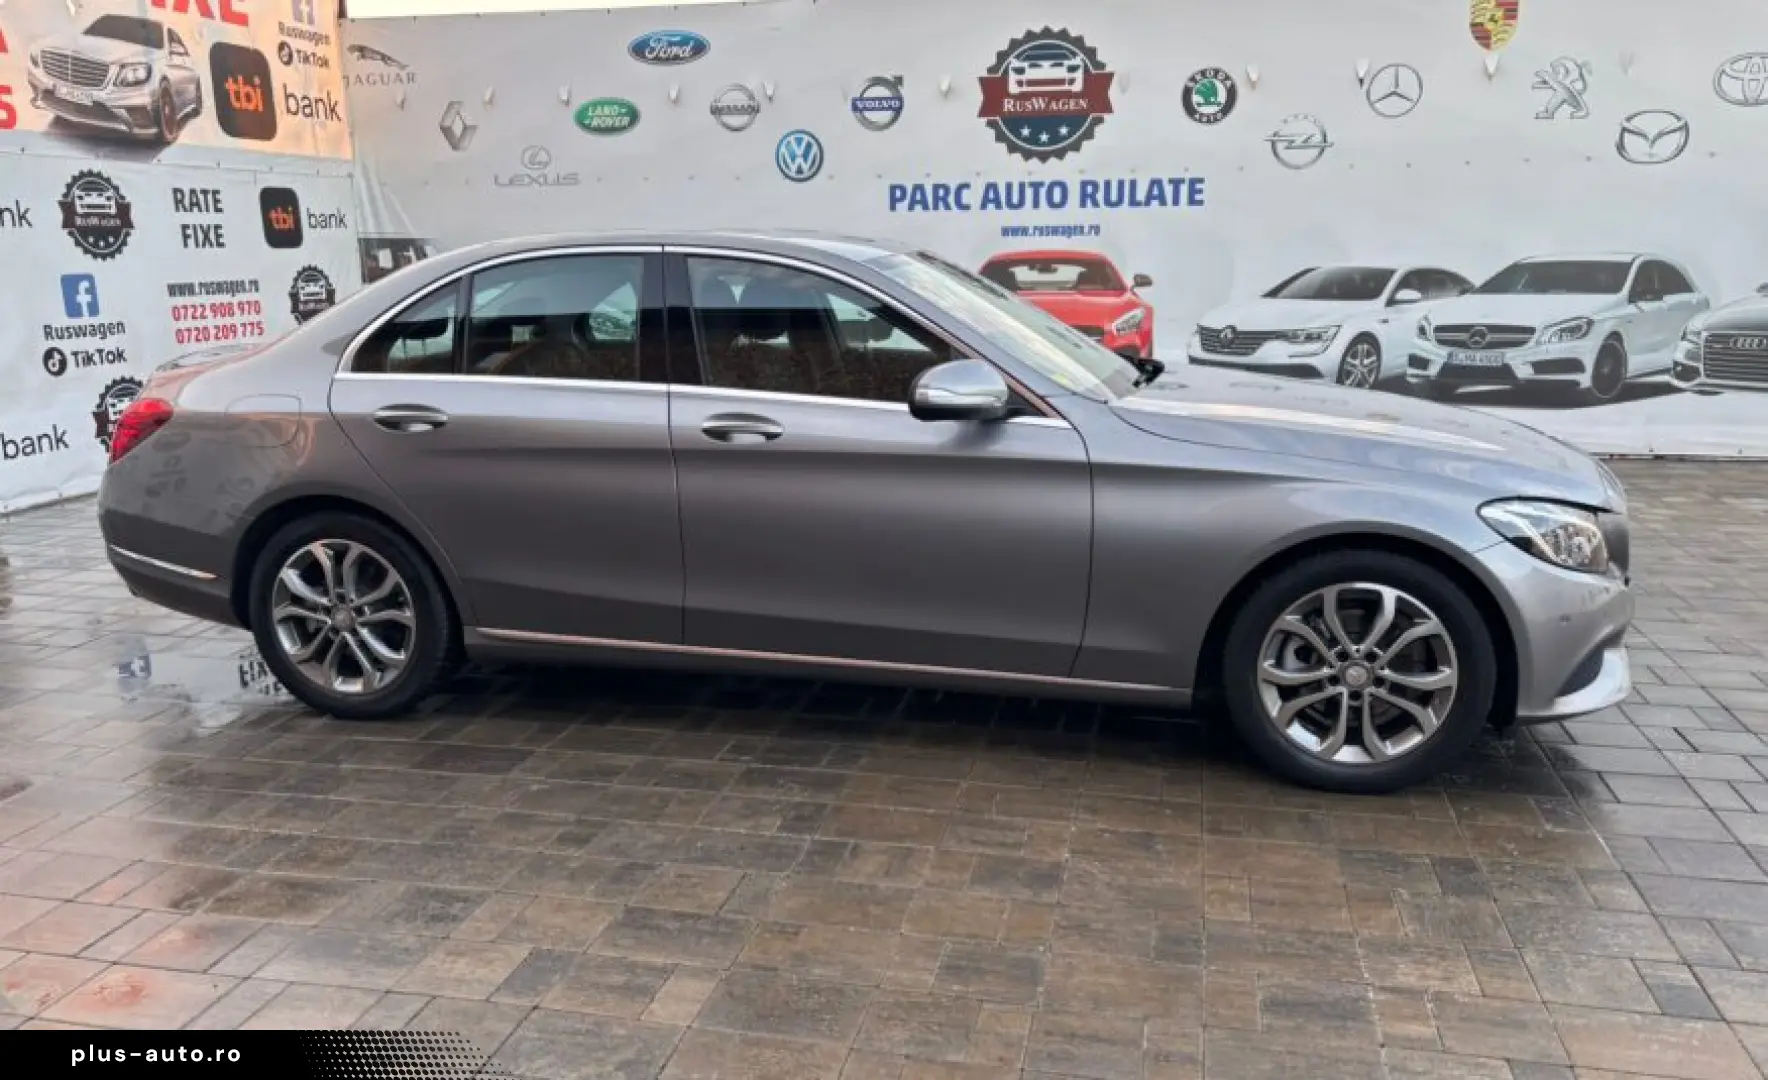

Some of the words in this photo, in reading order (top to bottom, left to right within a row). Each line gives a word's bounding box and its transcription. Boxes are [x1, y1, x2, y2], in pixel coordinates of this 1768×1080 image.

[645, 36, 694, 57] Ford
[295, 49, 330, 68] TikTok
[342, 72, 417, 90] JAGUAR
[224, 74, 264, 112] tbi
[283, 83, 341, 121] bank
[856, 100, 900, 108] VOLVO
[714, 104, 758, 113] NISSAN
[494, 173, 580, 186] LEXUS
[172, 187, 224, 213] RATE
[889, 183, 971, 212] PARC
[979, 181, 1069, 211] AUTO
[1078, 177, 1206, 209] RULATE
[268, 206, 295, 230] tbi
[307, 207, 348, 229] bank
[181, 223, 226, 248] FIXE
[1000, 224, 1100, 238] www.ruswagen.ro
[167, 278, 260, 297] www.ruswagen.ro
[171, 304, 208, 321] 0722
[209, 302, 235, 318] 908
[237, 300, 262, 316] 970
[43, 321, 126, 340] Ruswagen
[175, 327, 211, 344] 0720
[213, 323, 238, 340] 209
[240, 321, 265, 337] 775
[70, 347, 128, 368] TikTok
[0, 424, 69, 460] bank
